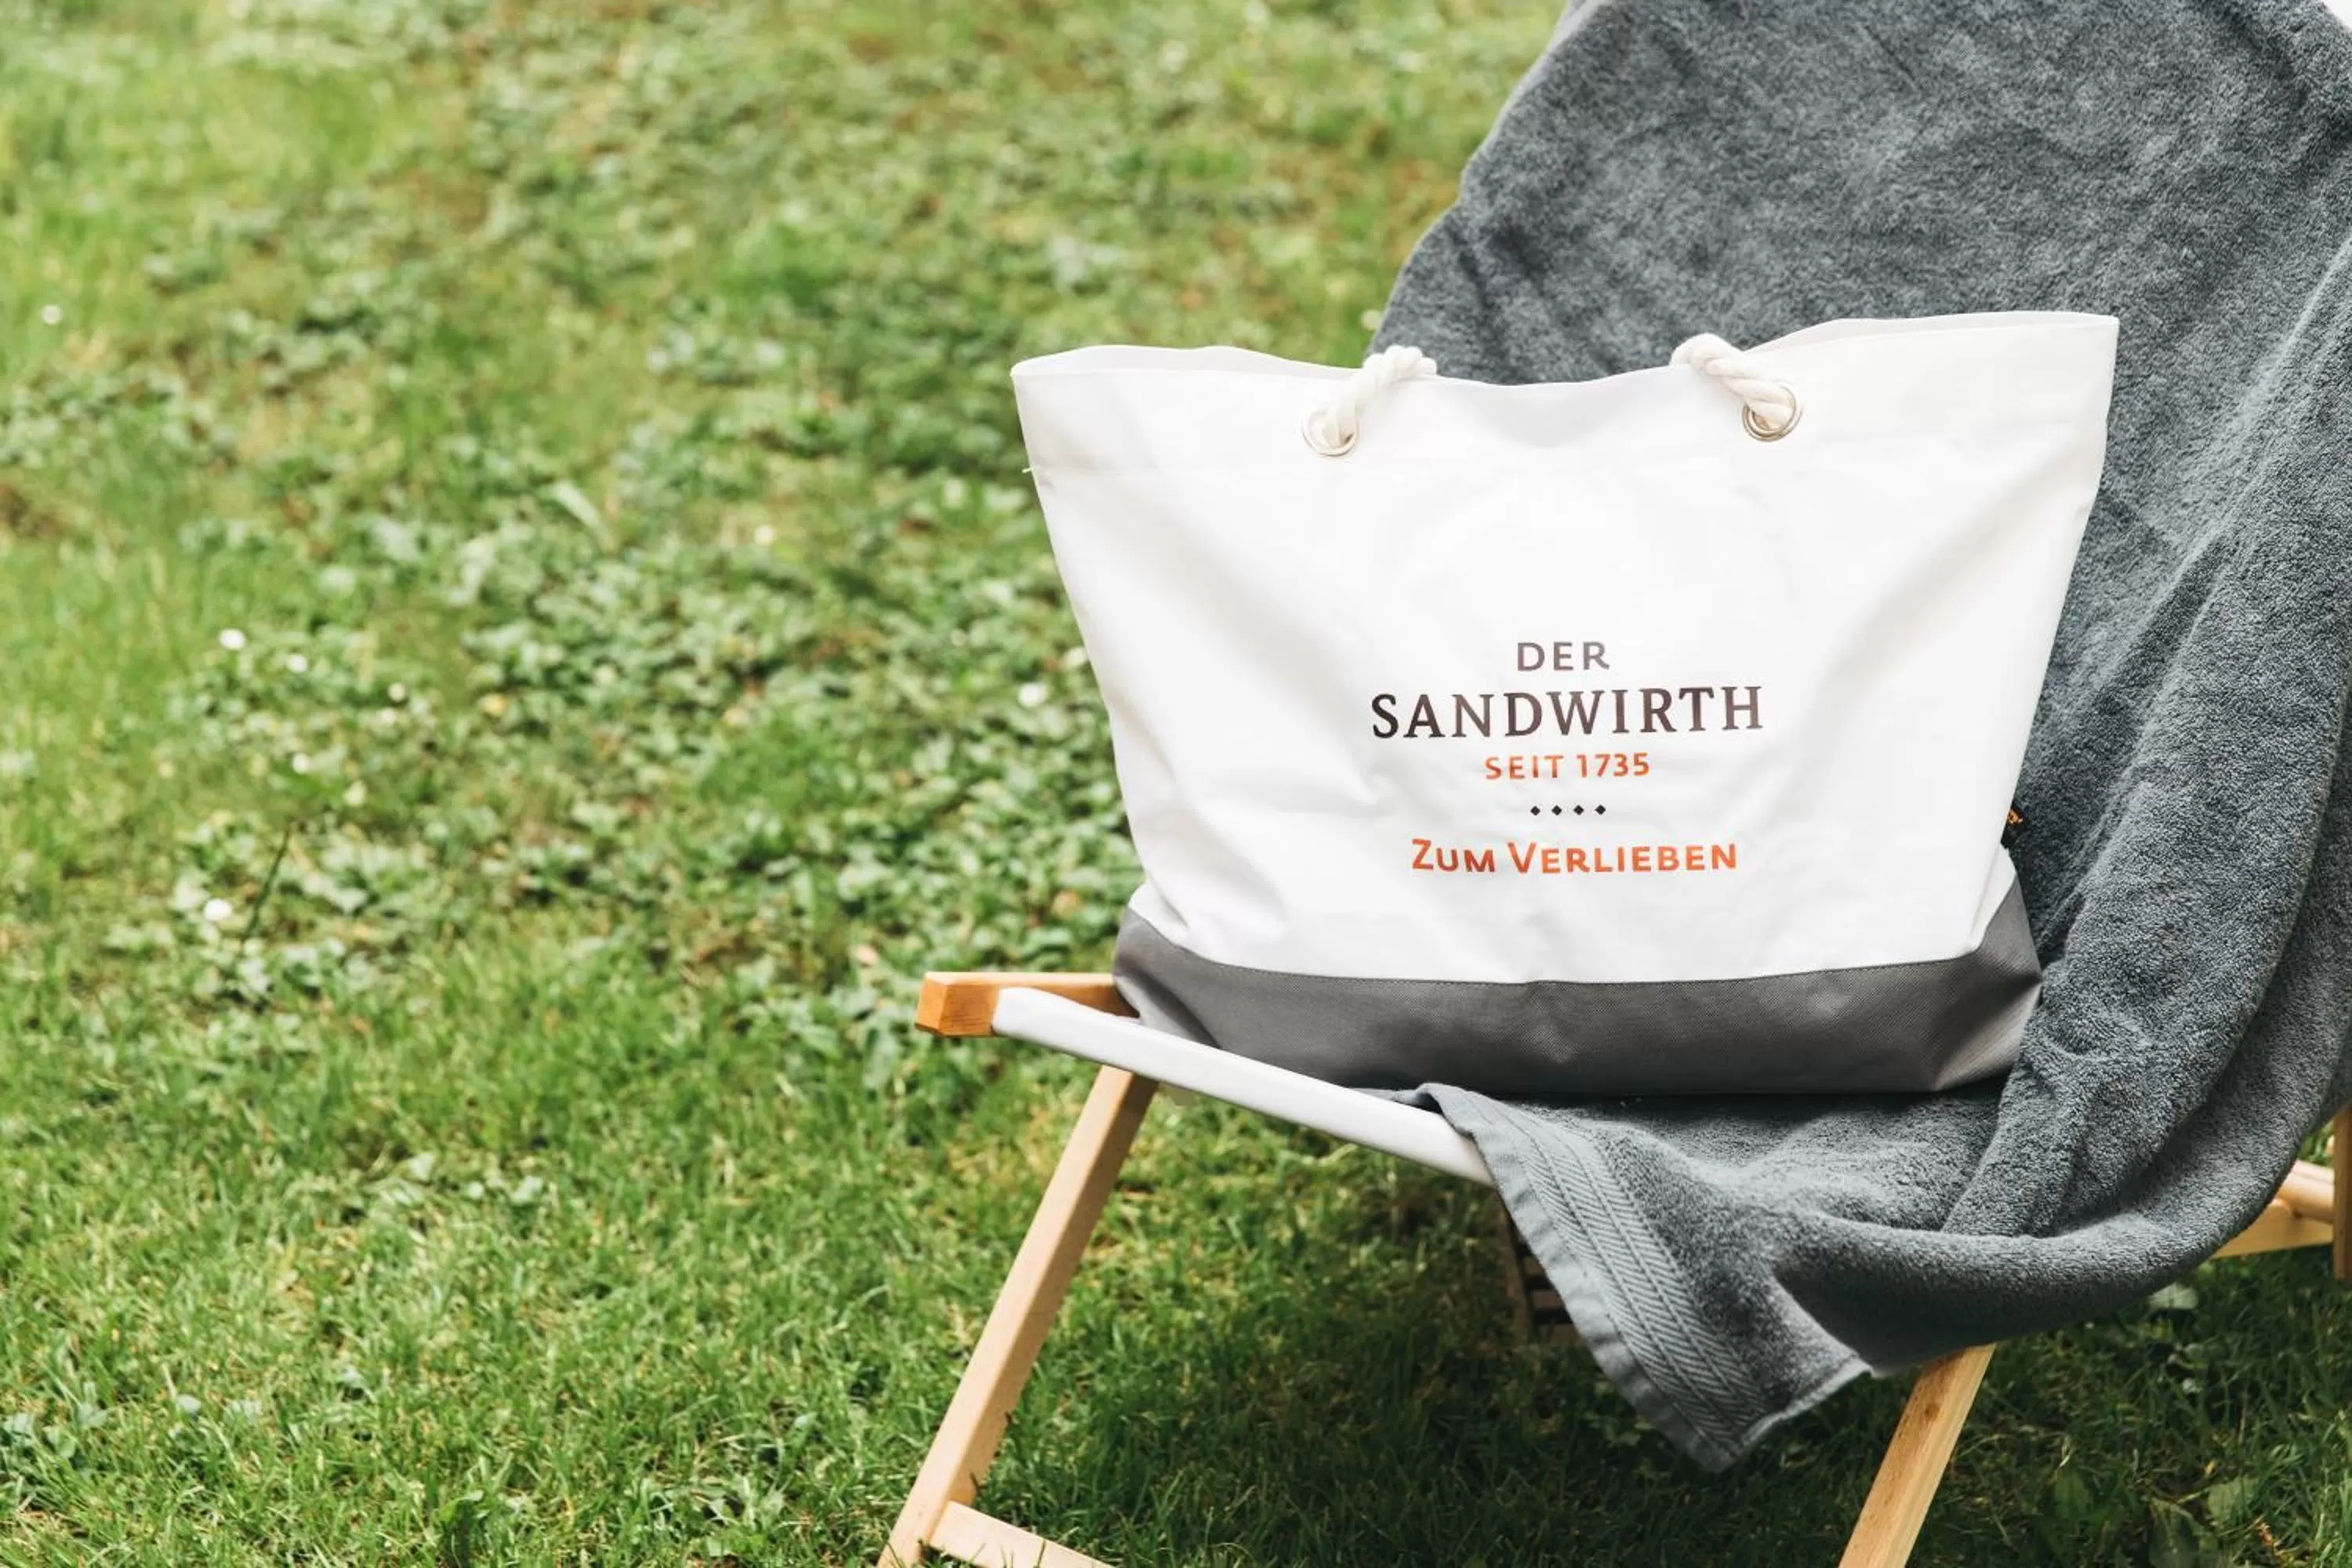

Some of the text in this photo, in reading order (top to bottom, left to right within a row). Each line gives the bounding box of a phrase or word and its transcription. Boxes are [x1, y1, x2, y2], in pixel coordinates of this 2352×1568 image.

[1516, 641, 1610, 673] DER
[1370, 685, 1764, 740] SANDWIRTH
[1483, 751, 1651, 781] SEIT 1735
[1410, 837, 1737, 875] ZUM VERLIEBEN
